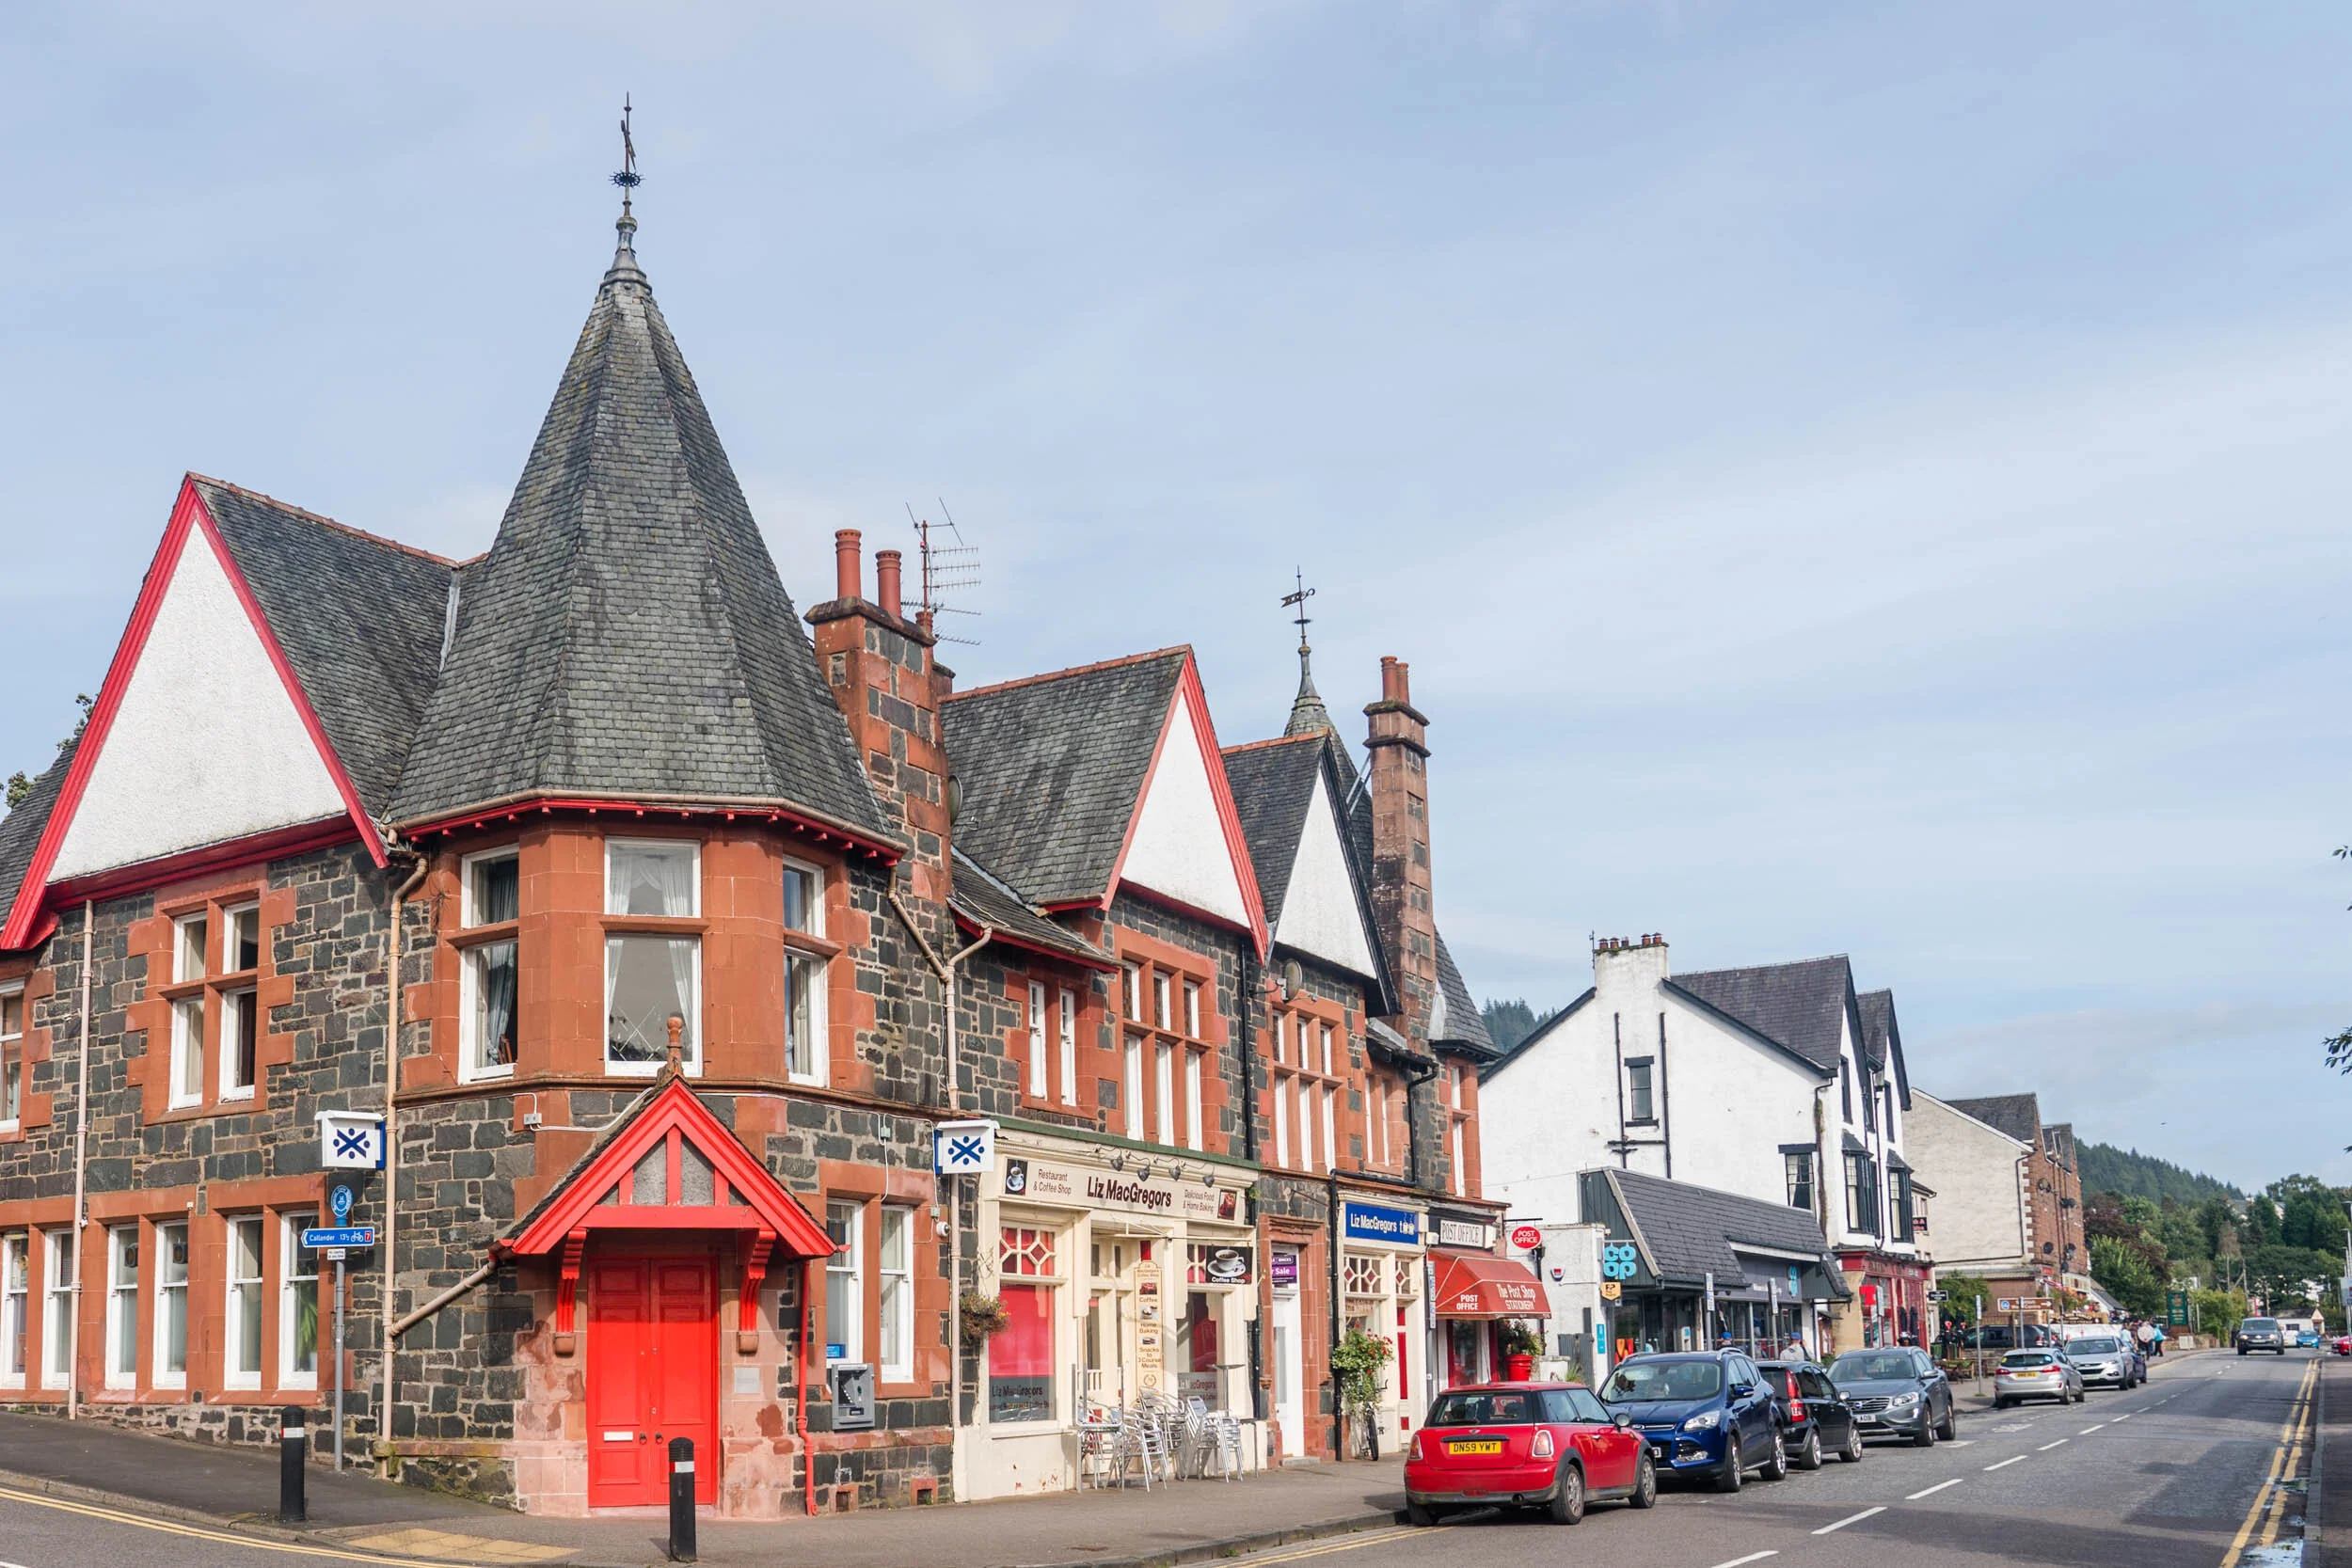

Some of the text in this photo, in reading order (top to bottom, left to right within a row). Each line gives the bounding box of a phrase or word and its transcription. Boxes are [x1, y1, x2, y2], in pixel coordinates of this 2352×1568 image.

[1038, 1168, 1068, 1182] Restaurant
[1033, 1181, 1072, 1196] & Coffee Shop
[1087, 1176, 1172, 1210] Liz MacGregors
[1203, 1191, 1215, 1202] Food
[1186, 1201, 1200, 1212] Home
[1200, 1202, 1214, 1215] Baking
[1350, 1212, 1360, 1227] Liz
[1360, 1213, 1397, 1234] MacGregors
[1441, 1223, 1480, 1243] POST OFFICE
[1603, 1246, 1636, 1261] co
[1275, 1266, 1290, 1275] Sale
[1603, 1261, 1636, 1279] op
[1496, 1284, 1536, 1302] The Post Shop
[1456, 1302, 1478, 1310] OFFICE
[992, 1385, 1043, 1399] Liz MacGregors
[1453, 1442, 1497, 1452] DN59 YWT
